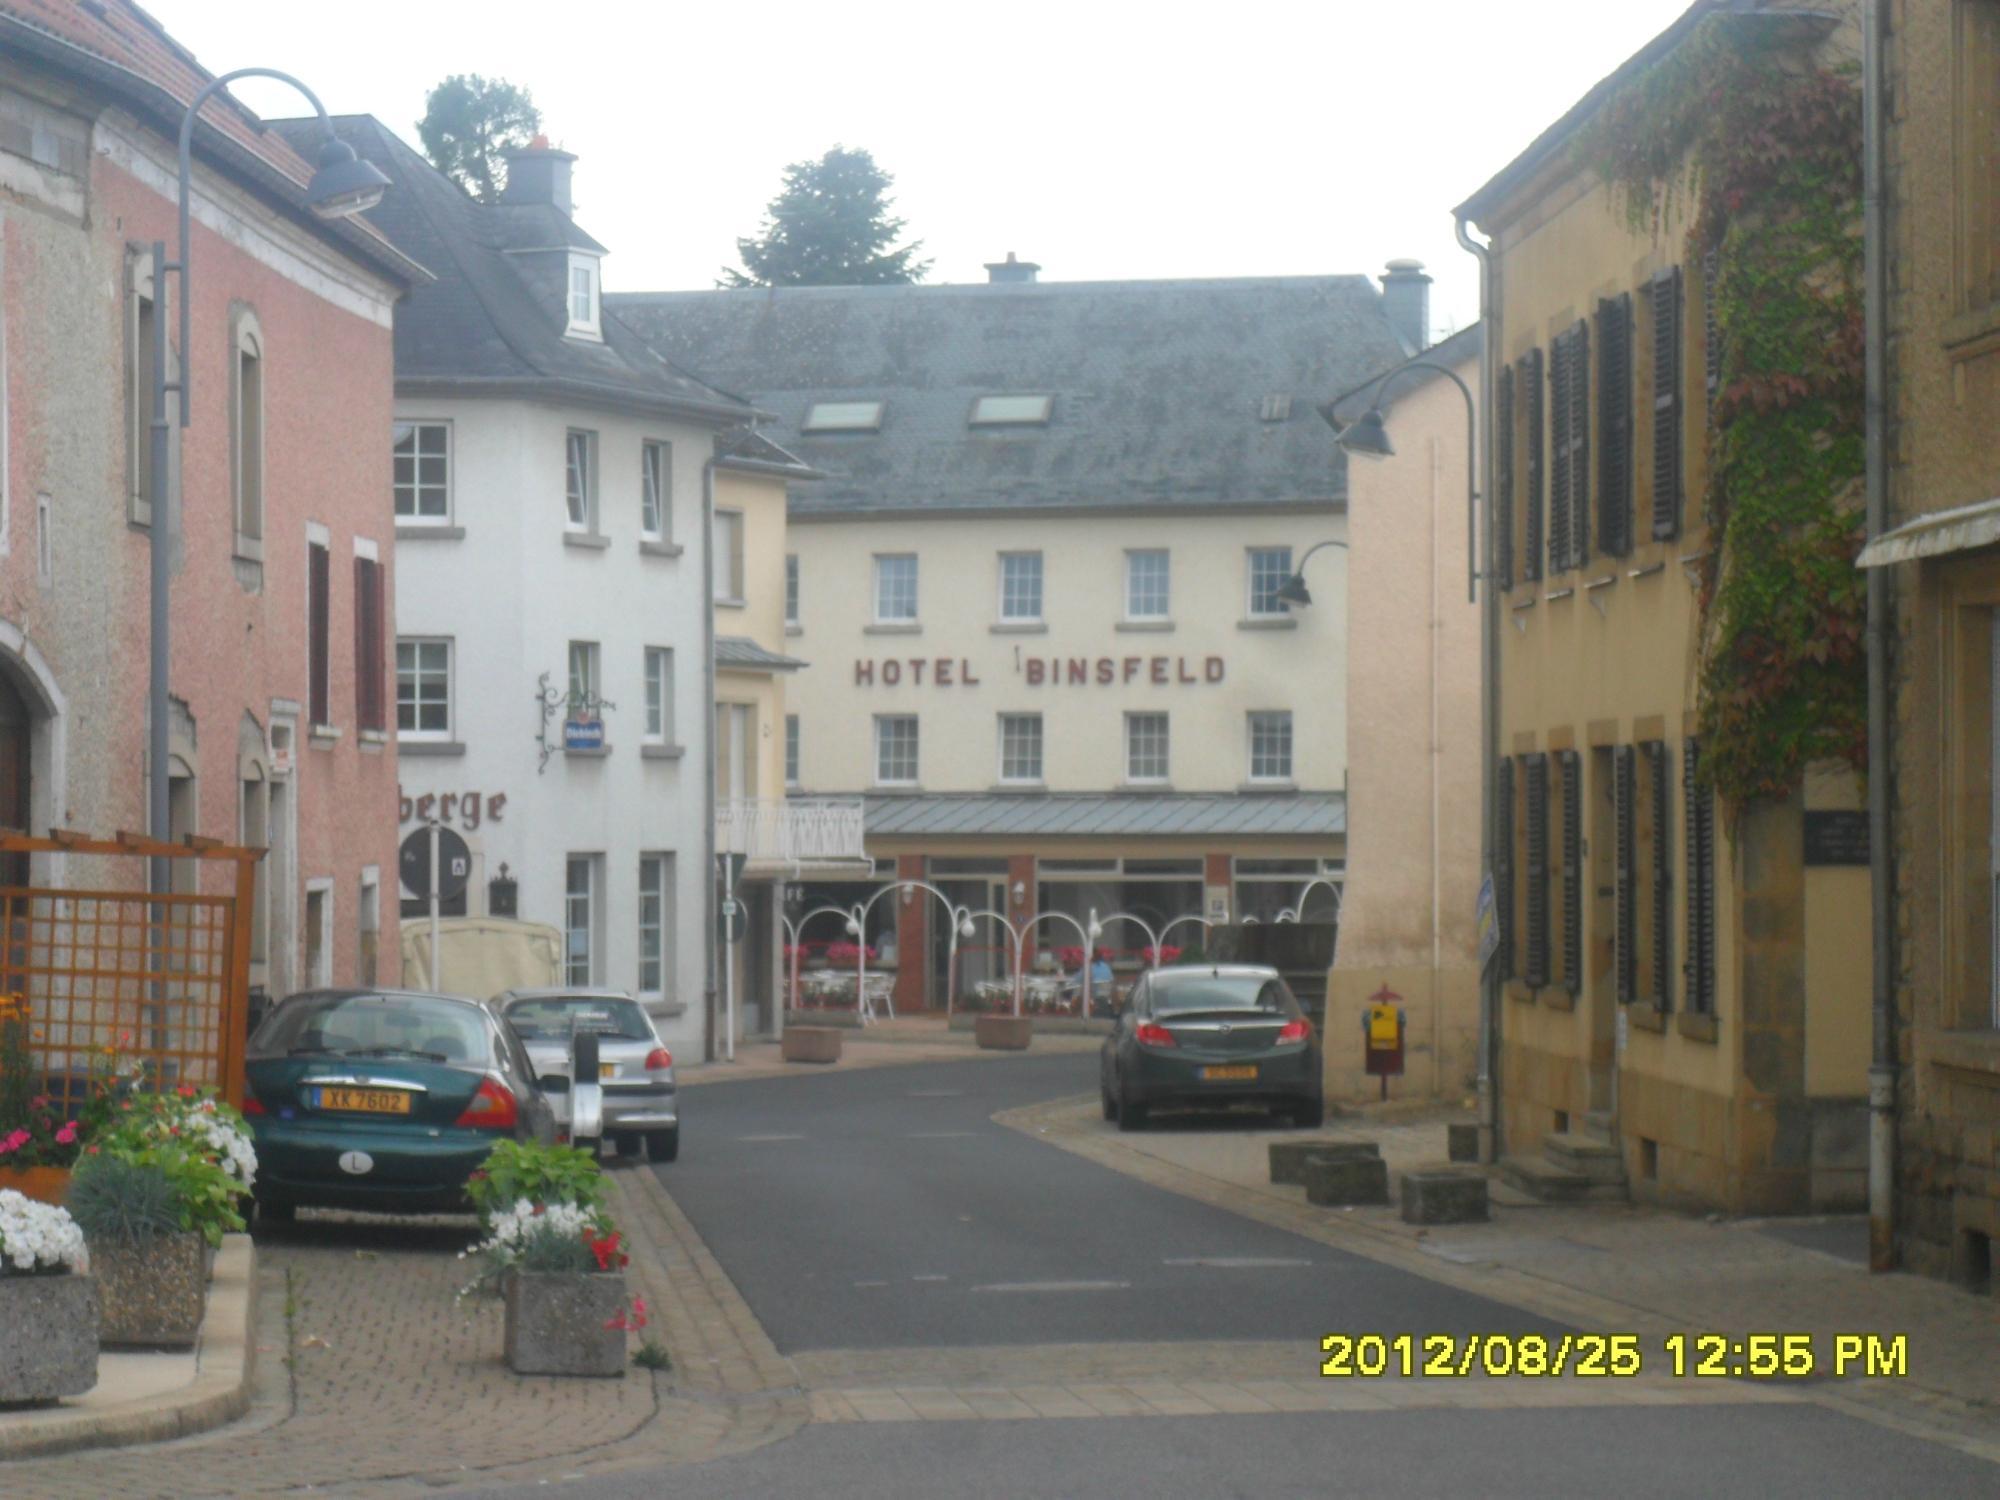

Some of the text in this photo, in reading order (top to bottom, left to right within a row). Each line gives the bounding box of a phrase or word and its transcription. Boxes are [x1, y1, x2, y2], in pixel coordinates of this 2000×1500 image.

[855, 656, 1225, 686] HOTEL BINSFELD
[330, 1088, 401, 1110] XK 7602
[351, 1153, 363, 1171] L
